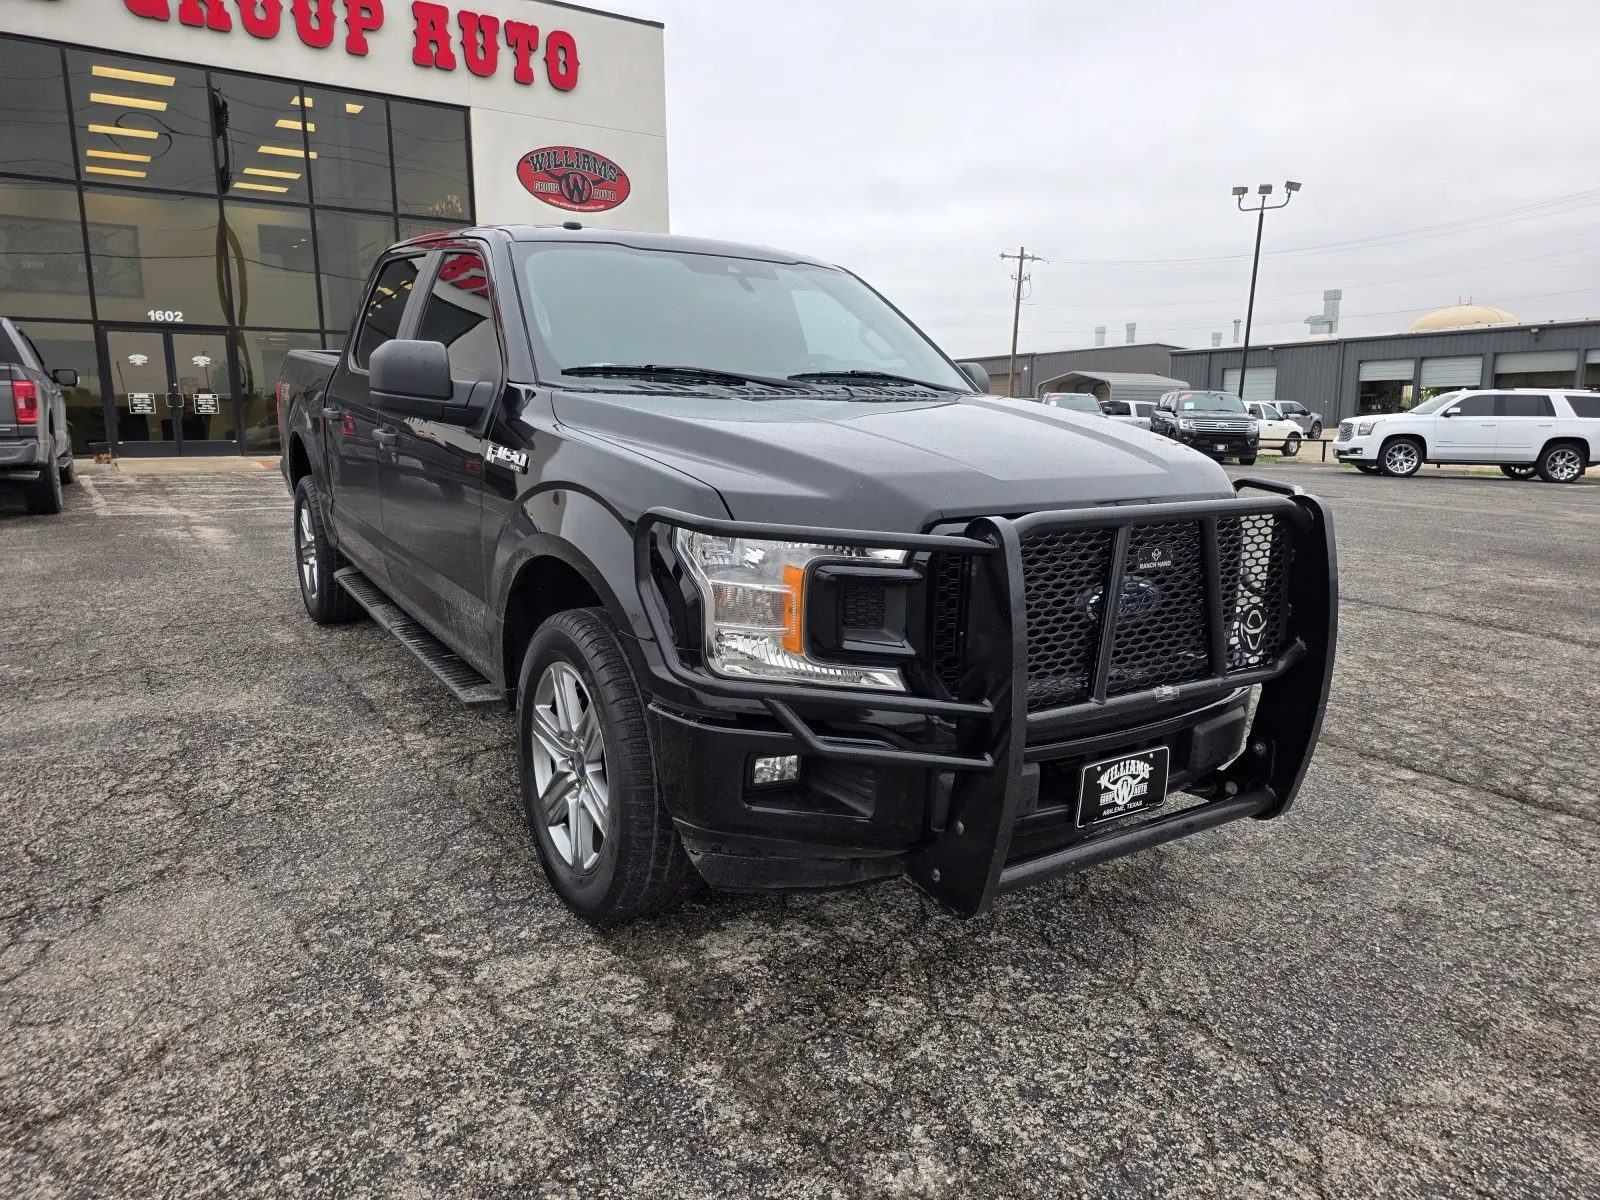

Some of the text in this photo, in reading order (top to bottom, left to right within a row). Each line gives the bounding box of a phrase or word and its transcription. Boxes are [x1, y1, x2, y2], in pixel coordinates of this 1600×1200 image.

[412, 0, 581, 91] AUTO
[529, 150, 618, 183] WILLIAMS
[534, 180, 560, 193] GROUP
[594, 188, 616, 201] AUTO
[147, 310, 184, 323] 1602
[1139, 560, 1172, 570] RANCH HAND
[1099, 759, 1151, 790] WILLIAMS
[1133, 783, 1149, 796] AUTO
[1102, 800, 1143, 817] ABILENE, TEXAS
